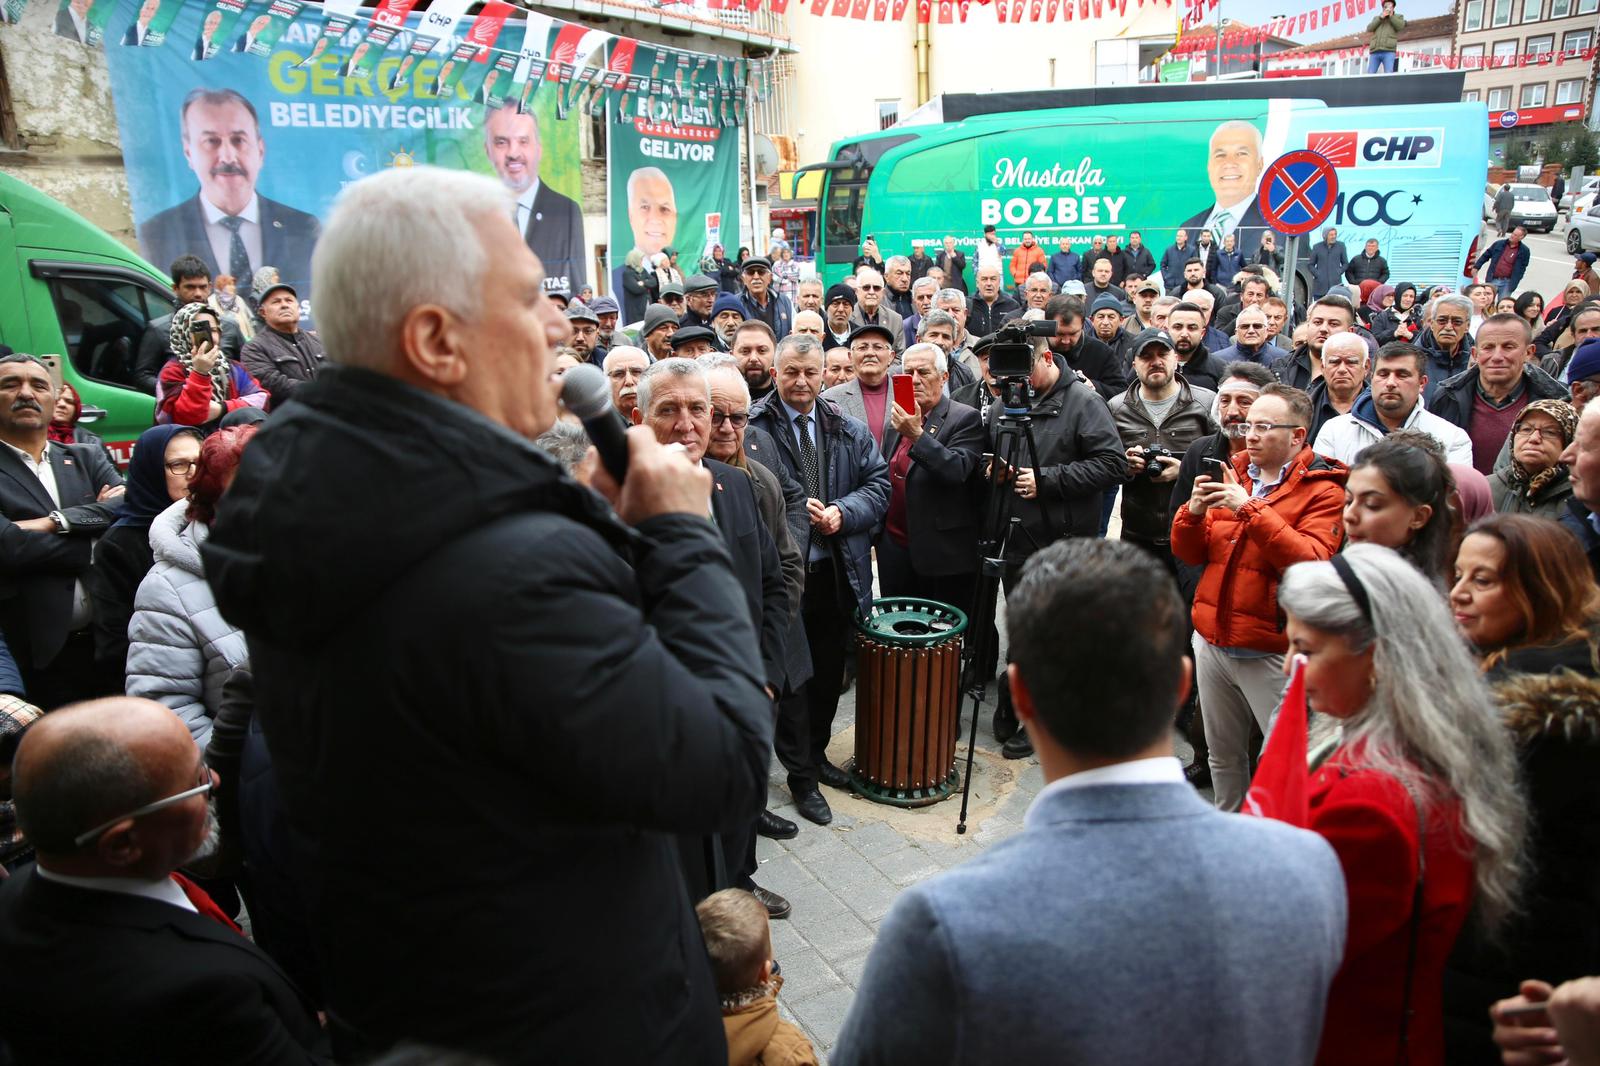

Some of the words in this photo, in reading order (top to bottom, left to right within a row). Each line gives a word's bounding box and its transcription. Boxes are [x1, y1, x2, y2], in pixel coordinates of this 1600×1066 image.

[377, 11, 401, 25] CHP
[429, 12, 452, 26] CHP
[268, 49, 471, 103] GERÇE
[269, 101, 474, 129] BELEDİYECİLİK
[639, 137, 715, 162] GELİYOR
[1363, 136, 1435, 162] CHP
[991, 156, 1106, 196] Mustafa
[981, 196, 1127, 225] BOZBEY
